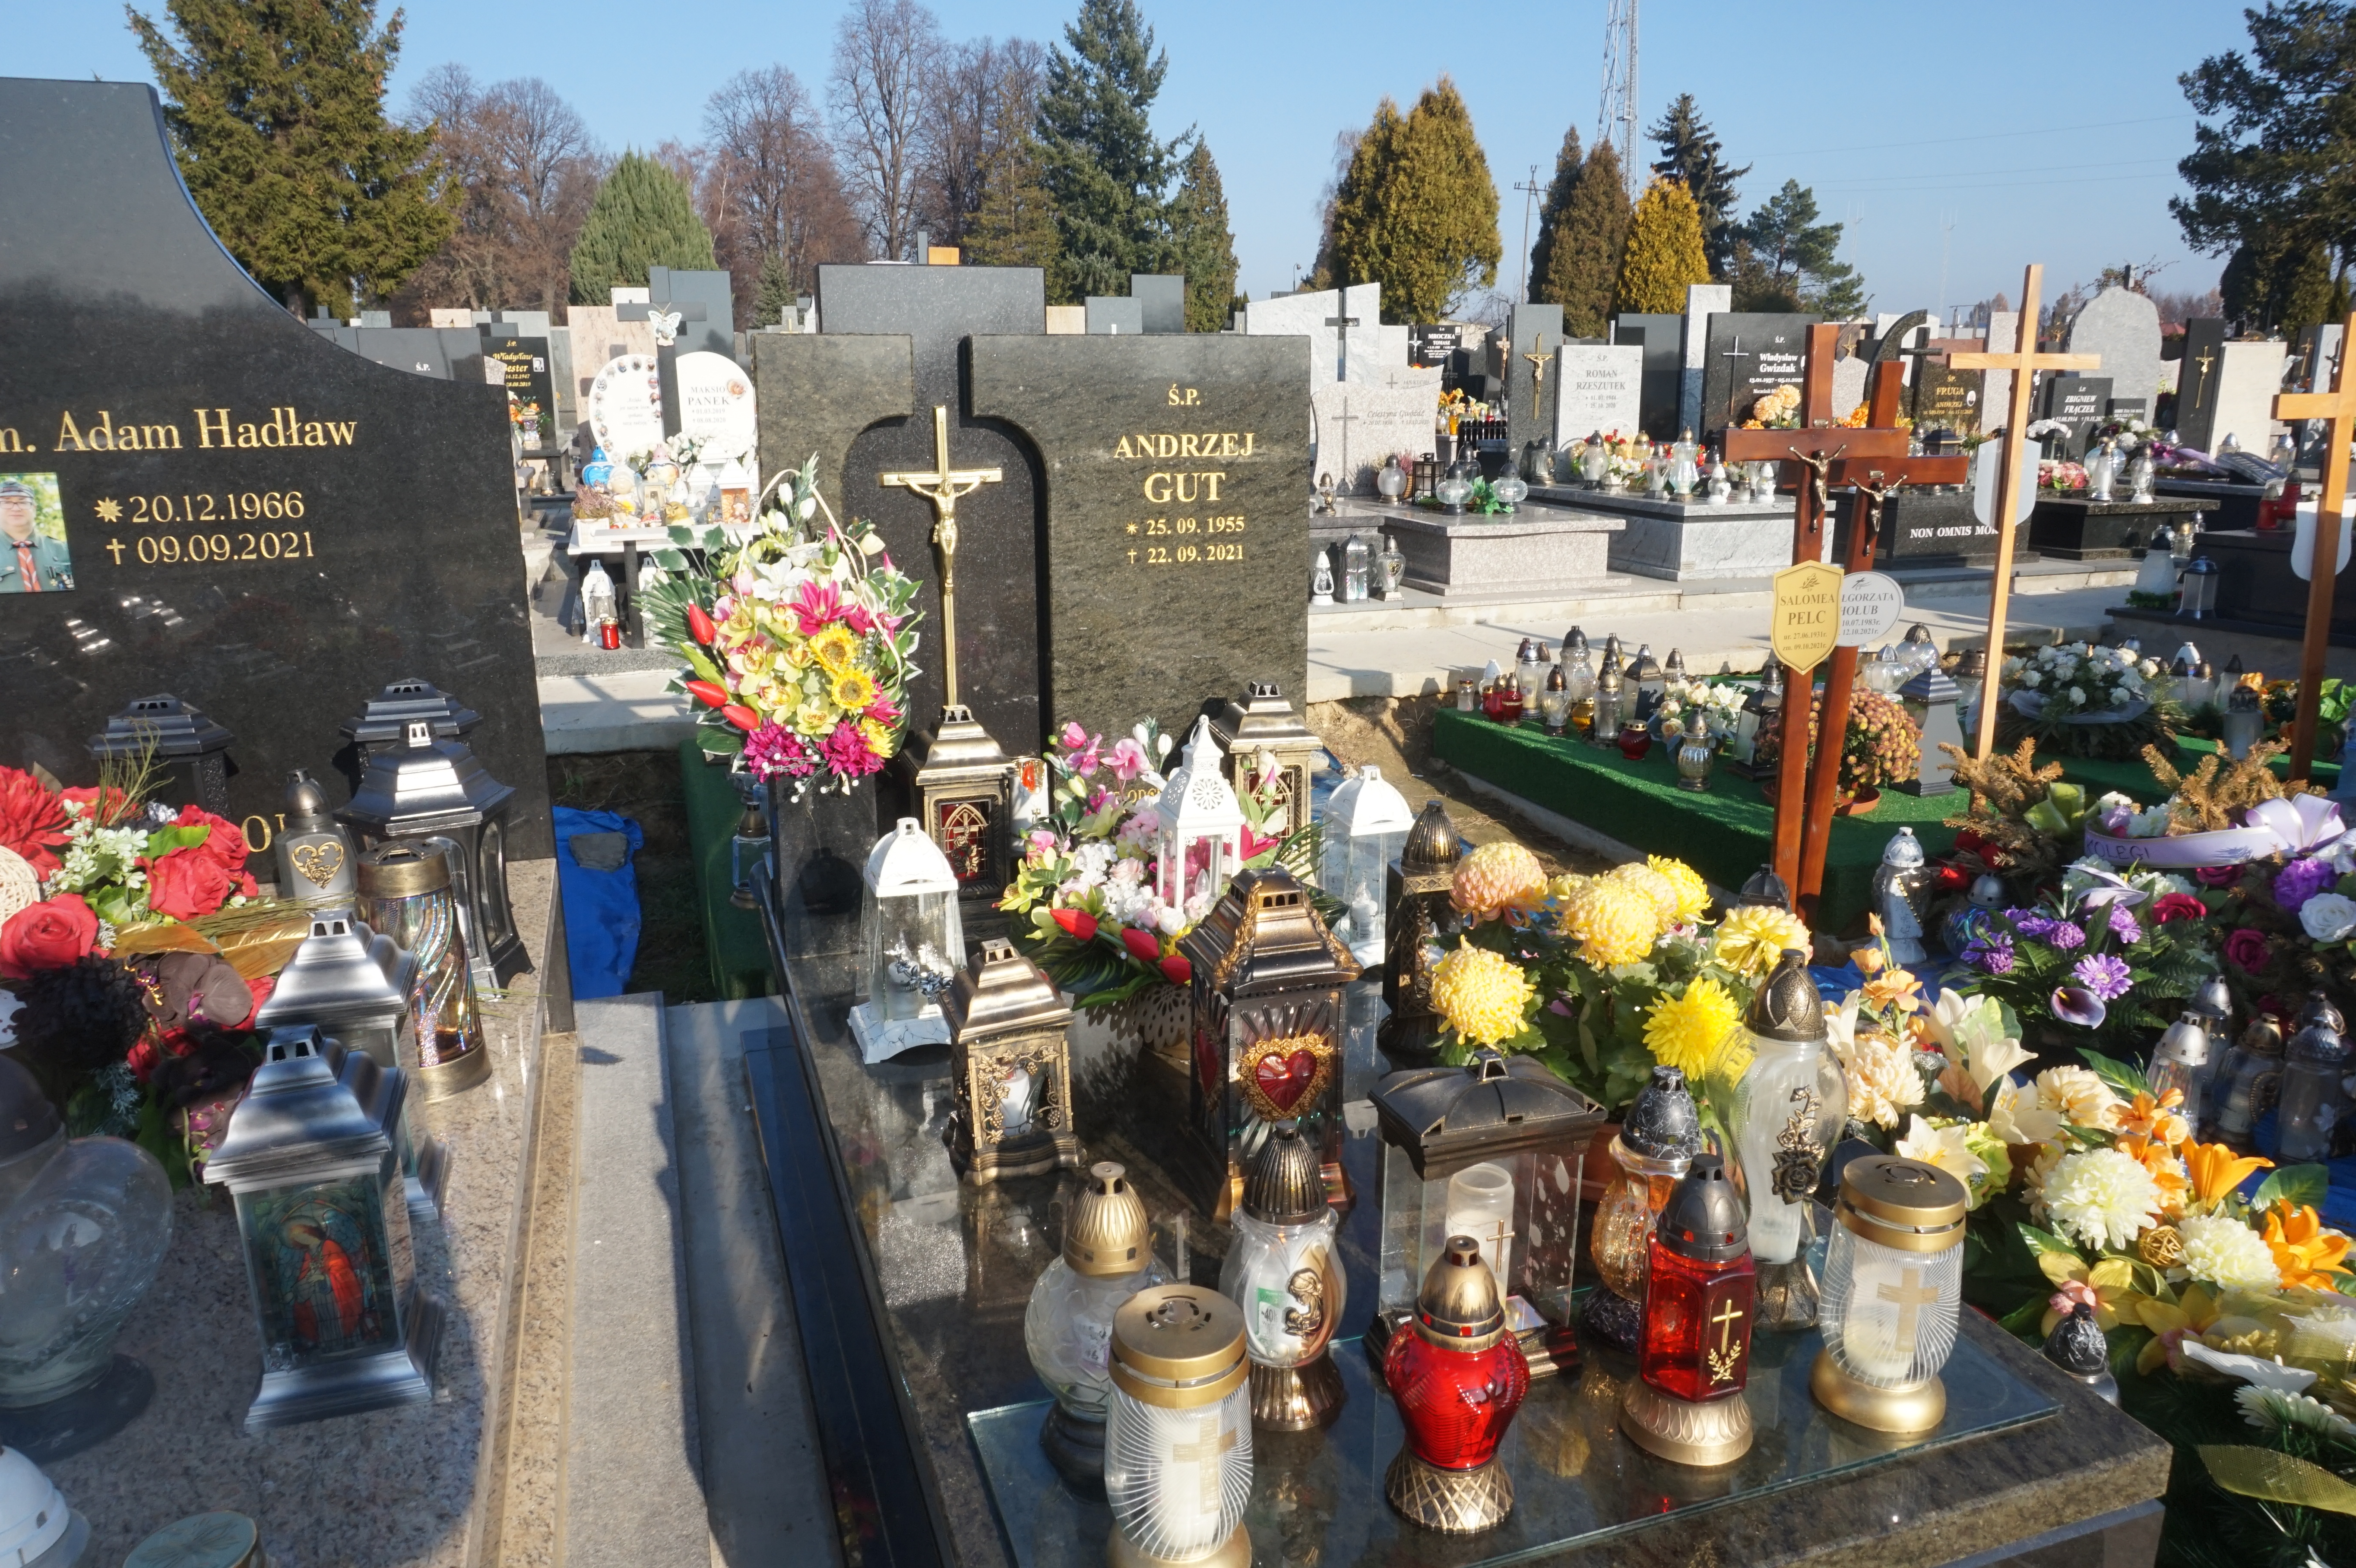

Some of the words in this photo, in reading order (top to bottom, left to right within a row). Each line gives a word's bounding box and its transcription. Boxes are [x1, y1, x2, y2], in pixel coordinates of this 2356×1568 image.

[1775, 335, 1786, 343] Ś.P.
[415, 362, 431, 371] Ś.P.
[1760, 363, 1796, 373] Gwizdak
[1586, 370, 1618, 378] ROMAN
[1576, 381, 1626, 390] RZESZUTEK
[1936, 387, 1965, 395] FRUGA
[1168, 384, 1200, 406] Ś.P.
[687, 396, 730, 406] PANEK
[2064, 405, 2096, 415] FRĄCZEK
[54, 410, 183, 452] Adam
[193, 407, 358, 449] Hadław
[1113, 433, 1254, 458] ANDRZEJ
[1144, 472, 1226, 503] GUT
[129, 491, 305, 523] 20.12.1966
[1146, 519, 1172, 535] 25.
[1176, 518, 1200, 534] 09.
[1206, 516, 1245, 533] 1955
[1910, 528, 1935, 539] NON
[1937, 526, 1972, 537] OMNIS
[138, 531, 314, 563] 09.09.2021
[1147, 547, 1172, 563] 22.
[1177, 547, 1201, 562] 09.
[1206, 544, 1244, 561] 2021
[1780, 594, 1835, 606] SALOMEA
[1841, 592, 1894, 603] ŁGORZATA
[1788, 610, 1827, 626] PELC
[1842, 618, 1881, 626] 10.07.1983r.
[1793, 631, 1827, 639] 27.06.1931r.
[1794, 642, 1827, 650] 09.10.2021r.
